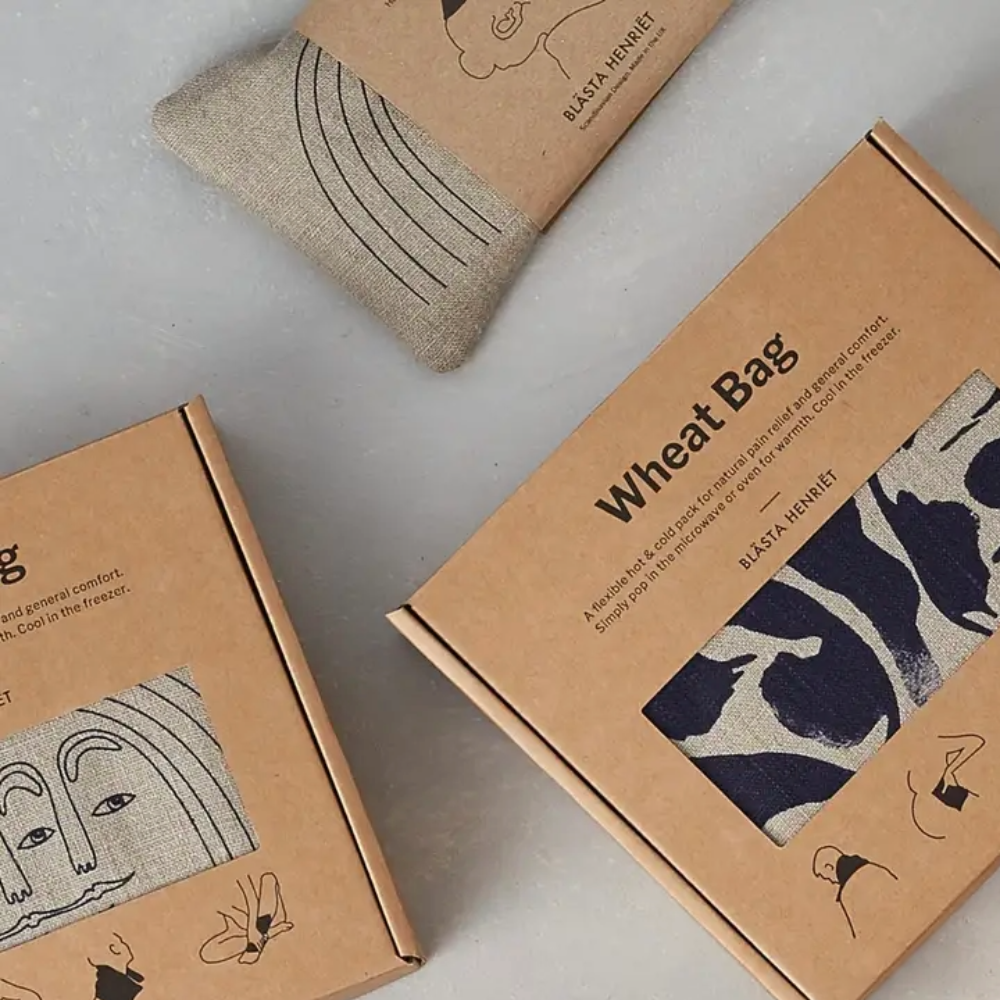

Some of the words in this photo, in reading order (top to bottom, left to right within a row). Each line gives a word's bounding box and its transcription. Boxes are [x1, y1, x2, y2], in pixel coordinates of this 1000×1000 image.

[563, 72, 608, 121] BLÄSTA
[605, 11, 654, 70] HENRIËT
[628, 54, 643, 70] Made
[584, 611, 594, 622] A
[592, 577, 628, 611] flexible
[625, 558, 646, 577] hot
[644, 549, 655, 559] &
[654, 526, 675, 550] cold
[675, 505, 699, 531] pack
[697, 489, 713, 505] for
[713, 454, 747, 490] natural
[747, 435, 768, 458] pain
[767, 406, 793, 435] relief
[793, 388, 812, 410] and
[811, 352, 848, 393] general
[847, 315, 888, 355] comfort.
[594, 403, 725, 522] Wheat
[711, 332, 798, 412] Bag
[595, 600, 629, 633] Simply
[628, 581, 648, 602] pop
[645, 570, 658, 581] in
[656, 554, 675, 570] the
[674, 502, 725, 554] microwave
[725, 490, 736, 503] or
[736, 467, 761, 491] oven
[759, 450, 775, 467] for
[774, 415, 815, 451] warmth.
[812, 388, 836, 413] Cool
[833, 380, 847, 391] in
[844, 363, 864, 380] the
[861, 327, 900, 363] freezer.
[739, 524, 786, 569] BLÄSTA
[784, 469, 836, 523] HENRIËT
[1, 606, 23, 623] and
[25, 587, 70, 615] general
[72, 568, 123, 594] comfort.
[17, 616, 45, 634] Cool
[46, 613, 58, 622] in
[60, 604, 81, 617] the
[83, 585, 130, 608] freezer.
